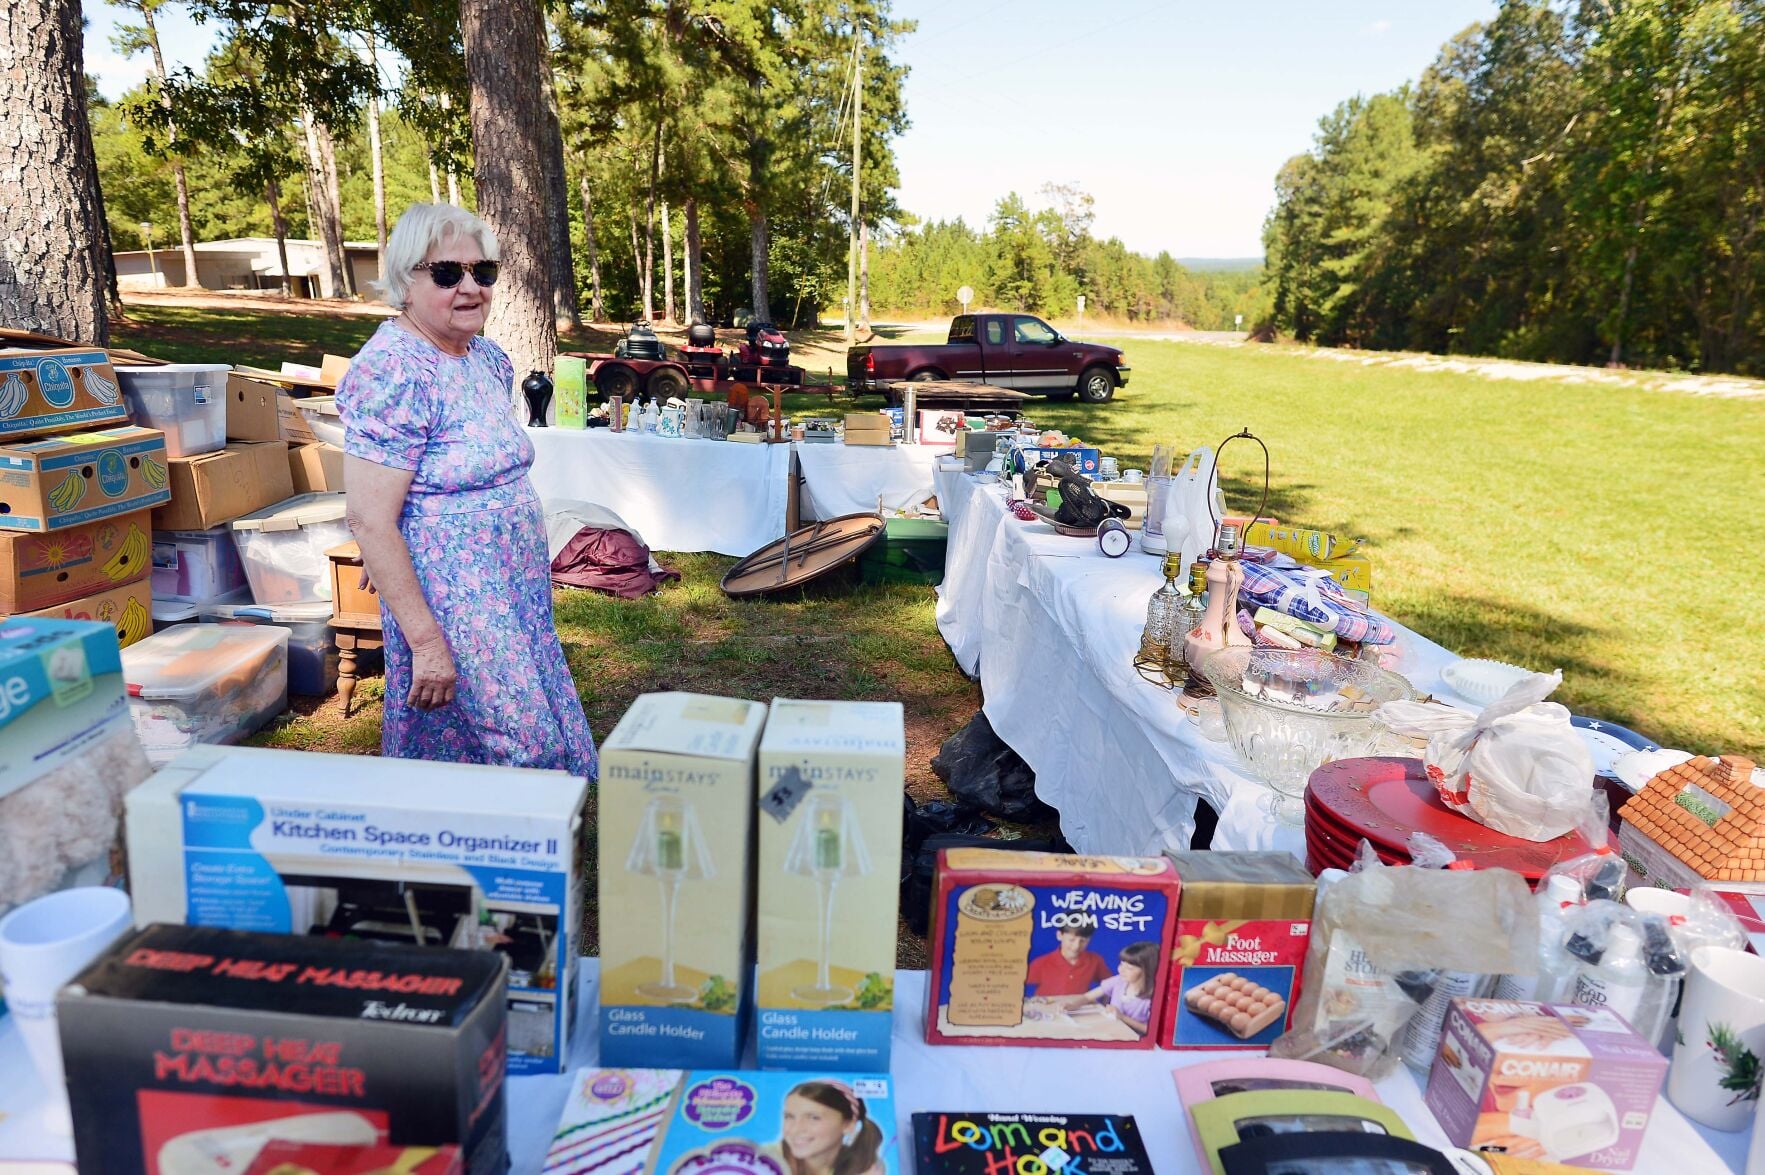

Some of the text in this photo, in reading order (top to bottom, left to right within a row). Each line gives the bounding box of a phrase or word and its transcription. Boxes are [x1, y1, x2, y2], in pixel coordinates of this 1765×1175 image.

[44, 382, 70, 393] Chiquita
[101, 473, 126, 485] Chiquita
[271, 807, 367, 822] Under Cabinet
[273, 820, 356, 841] Kitchen
[364, 825, 430, 846] Space
[438, 830, 540, 853] Organizer
[320, 843, 559, 869] Contemporary Stainless and Black Design
[1051, 890, 1144, 912] WEAVING
[1041, 911, 1153, 931] LOOM SET
[1226, 933, 1261, 950] Foot
[1206, 947, 1278, 965] Massager
[124, 948, 463, 996] DEEP HEAT MASSAGER
[608, 1008, 645, 1021] Glass
[762, 1011, 798, 1025] Glass
[1465, 1001, 1544, 1017] CONAIR
[608, 1022, 704, 1040] Candle Holder
[762, 1026, 858, 1041] Candle Holder
[1450, 1010, 1493, 1062] CONAIR
[171, 1028, 344, 1065] DEEP HEAT
[154, 1052, 366, 1096] MASSAGER
[1501, 1058, 1582, 1080] CONAIR
[988, 1113, 1068, 1124] Hand Weaving
[934, 1114, 1125, 1153] Loom and
[1589, 1152, 1628, 1167] Dryer
